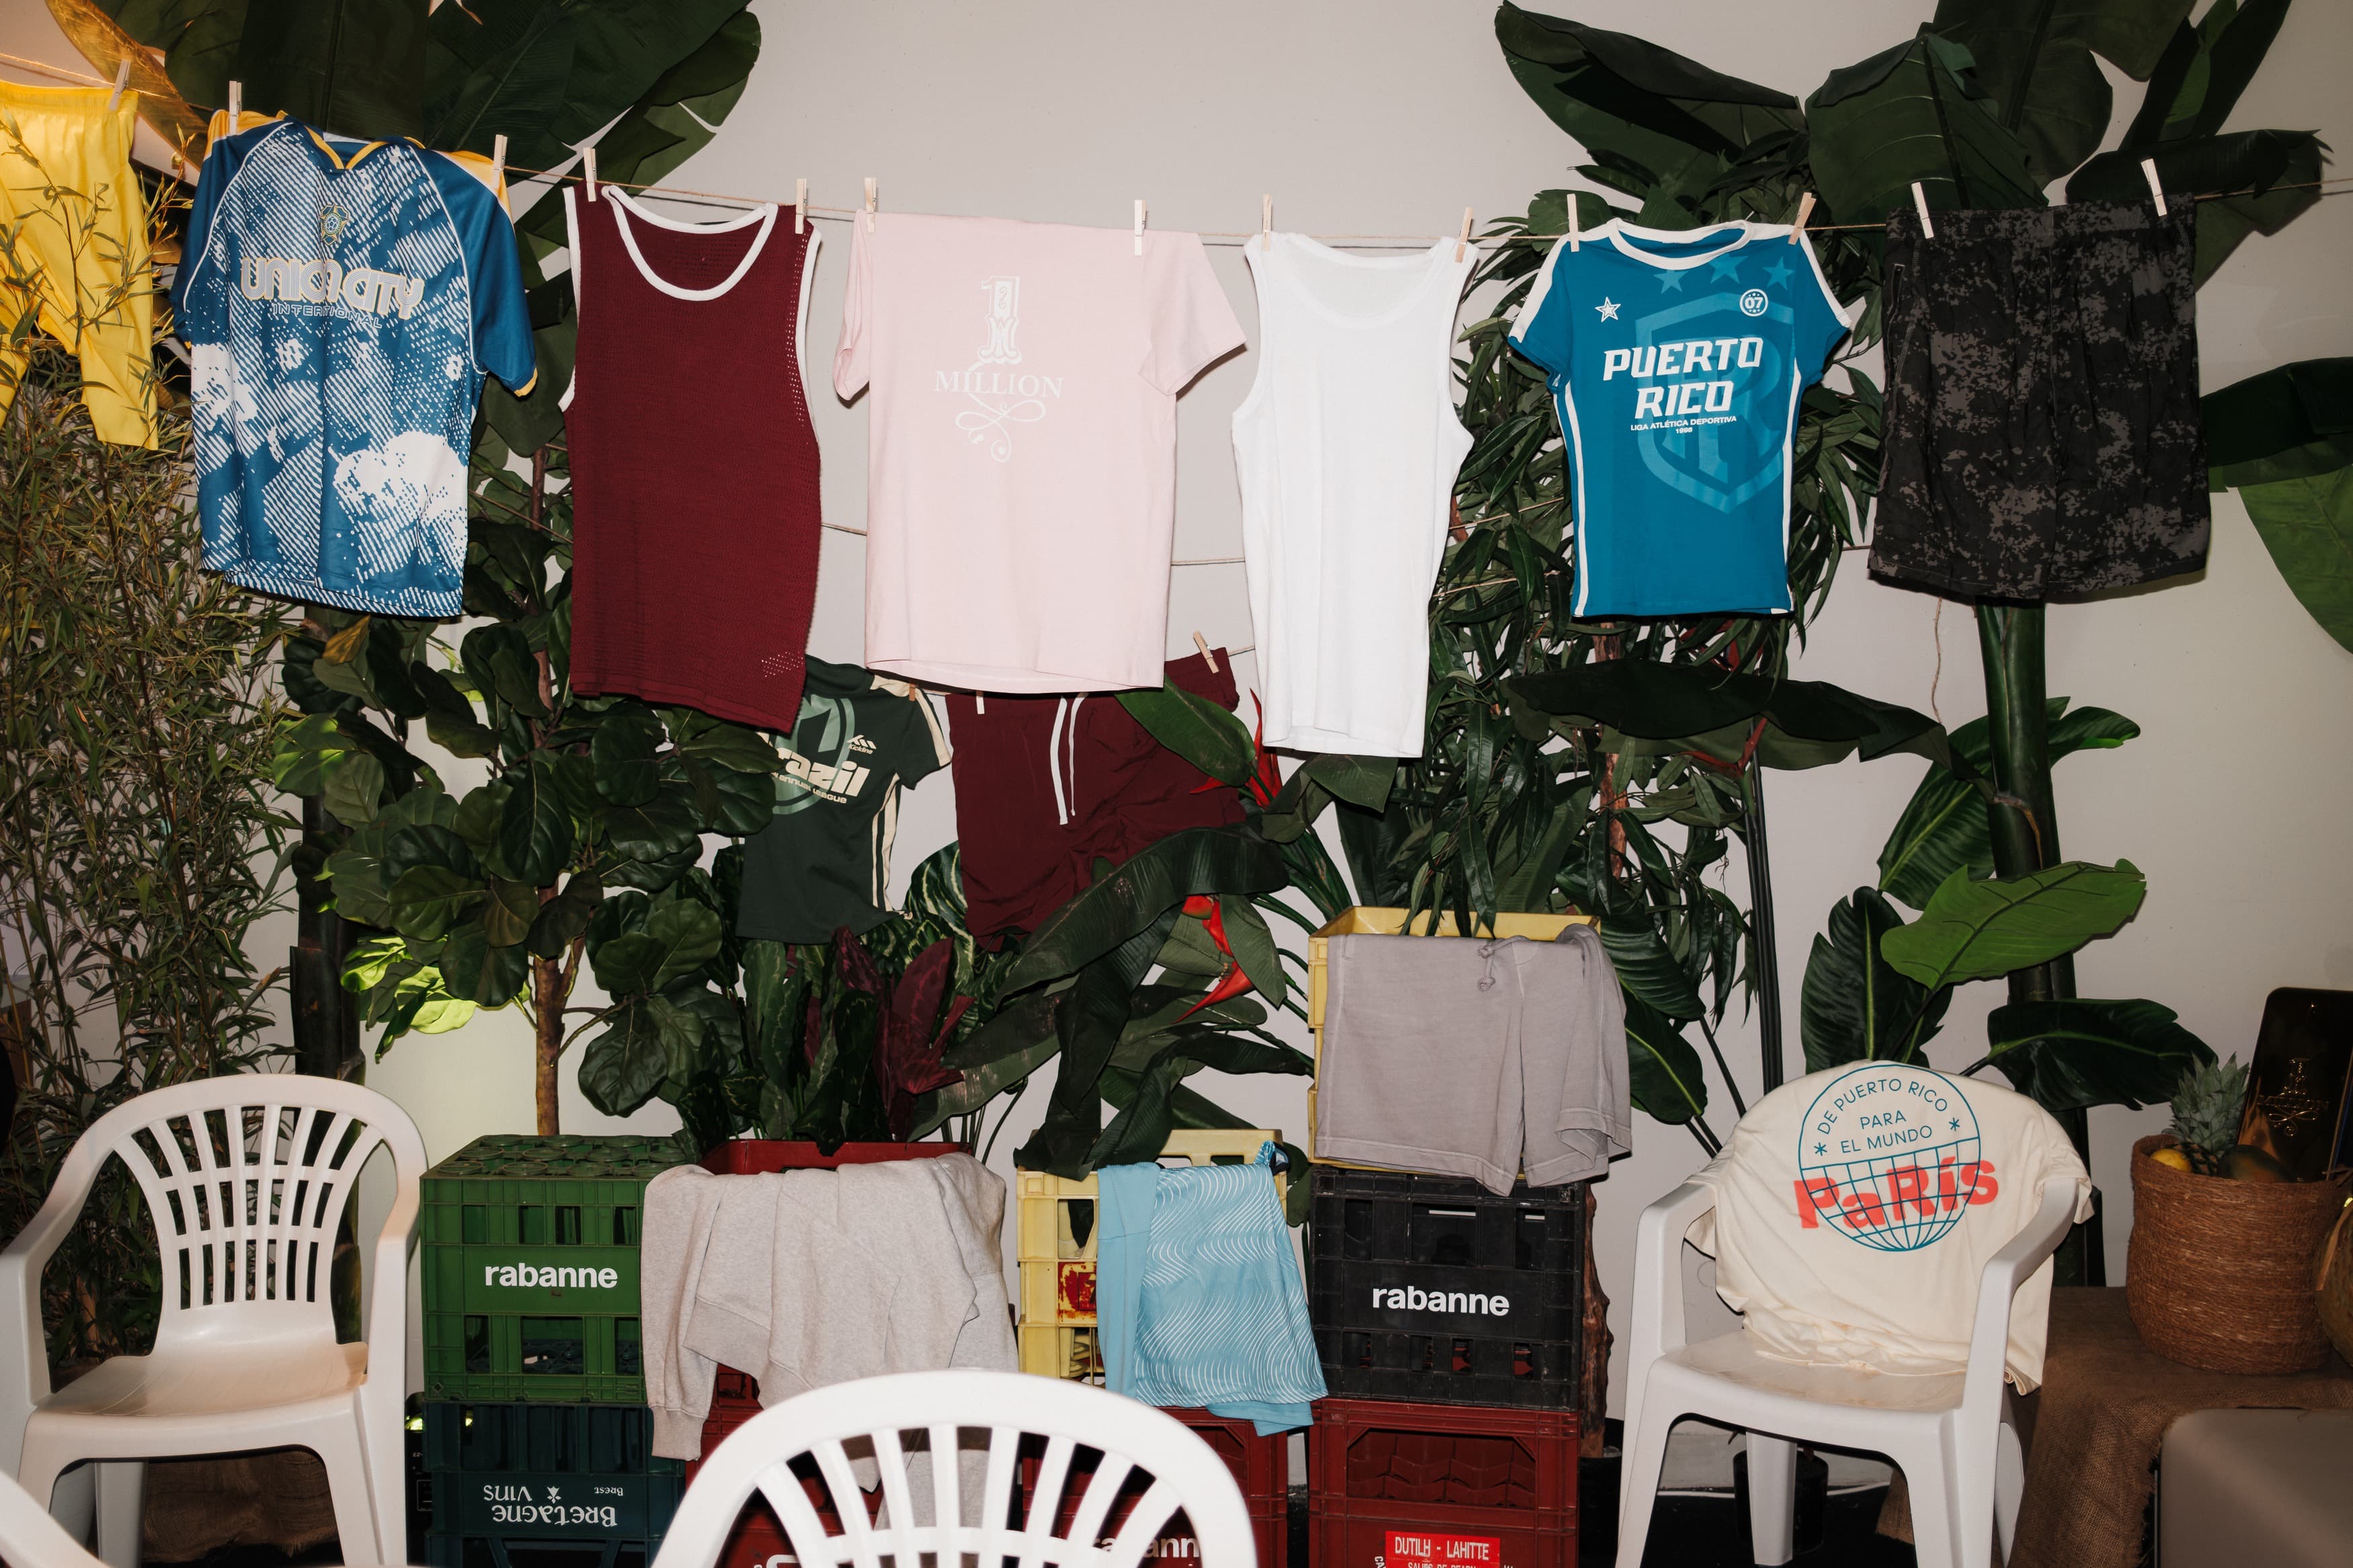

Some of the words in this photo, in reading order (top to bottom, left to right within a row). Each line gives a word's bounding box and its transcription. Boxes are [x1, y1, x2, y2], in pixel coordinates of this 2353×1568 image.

[273, 304, 382, 329] INTERTIONAL
[1745, 296, 1763, 309] 07
[978, 276, 1023, 365] 1
[1603, 337, 1763, 380] PUERTO
[935, 370, 1064, 399] MILLION
[1635, 380, 1734, 419] RICO
[1650, 419, 1689, 430] ATLÉTICA
[1690, 415, 1737, 426] DEPORTIVA
[1817, 1110, 1837, 1134] DE
[1833, 1079, 1901, 1111] PUERTO
[1908, 1081, 1947, 1112] RICO
[1860, 1110, 1907, 1130] PARA
[1841, 1139, 1861, 1153] EL
[1867, 1125, 1932, 1150] MUNDO
[485, 1262, 618, 1288] rabanne
[1372, 1286, 1510, 1317] rabanne
[1395, 1536, 1431, 1557] DUTILH
[1447, 1540, 1489, 1560] LAHITTE
